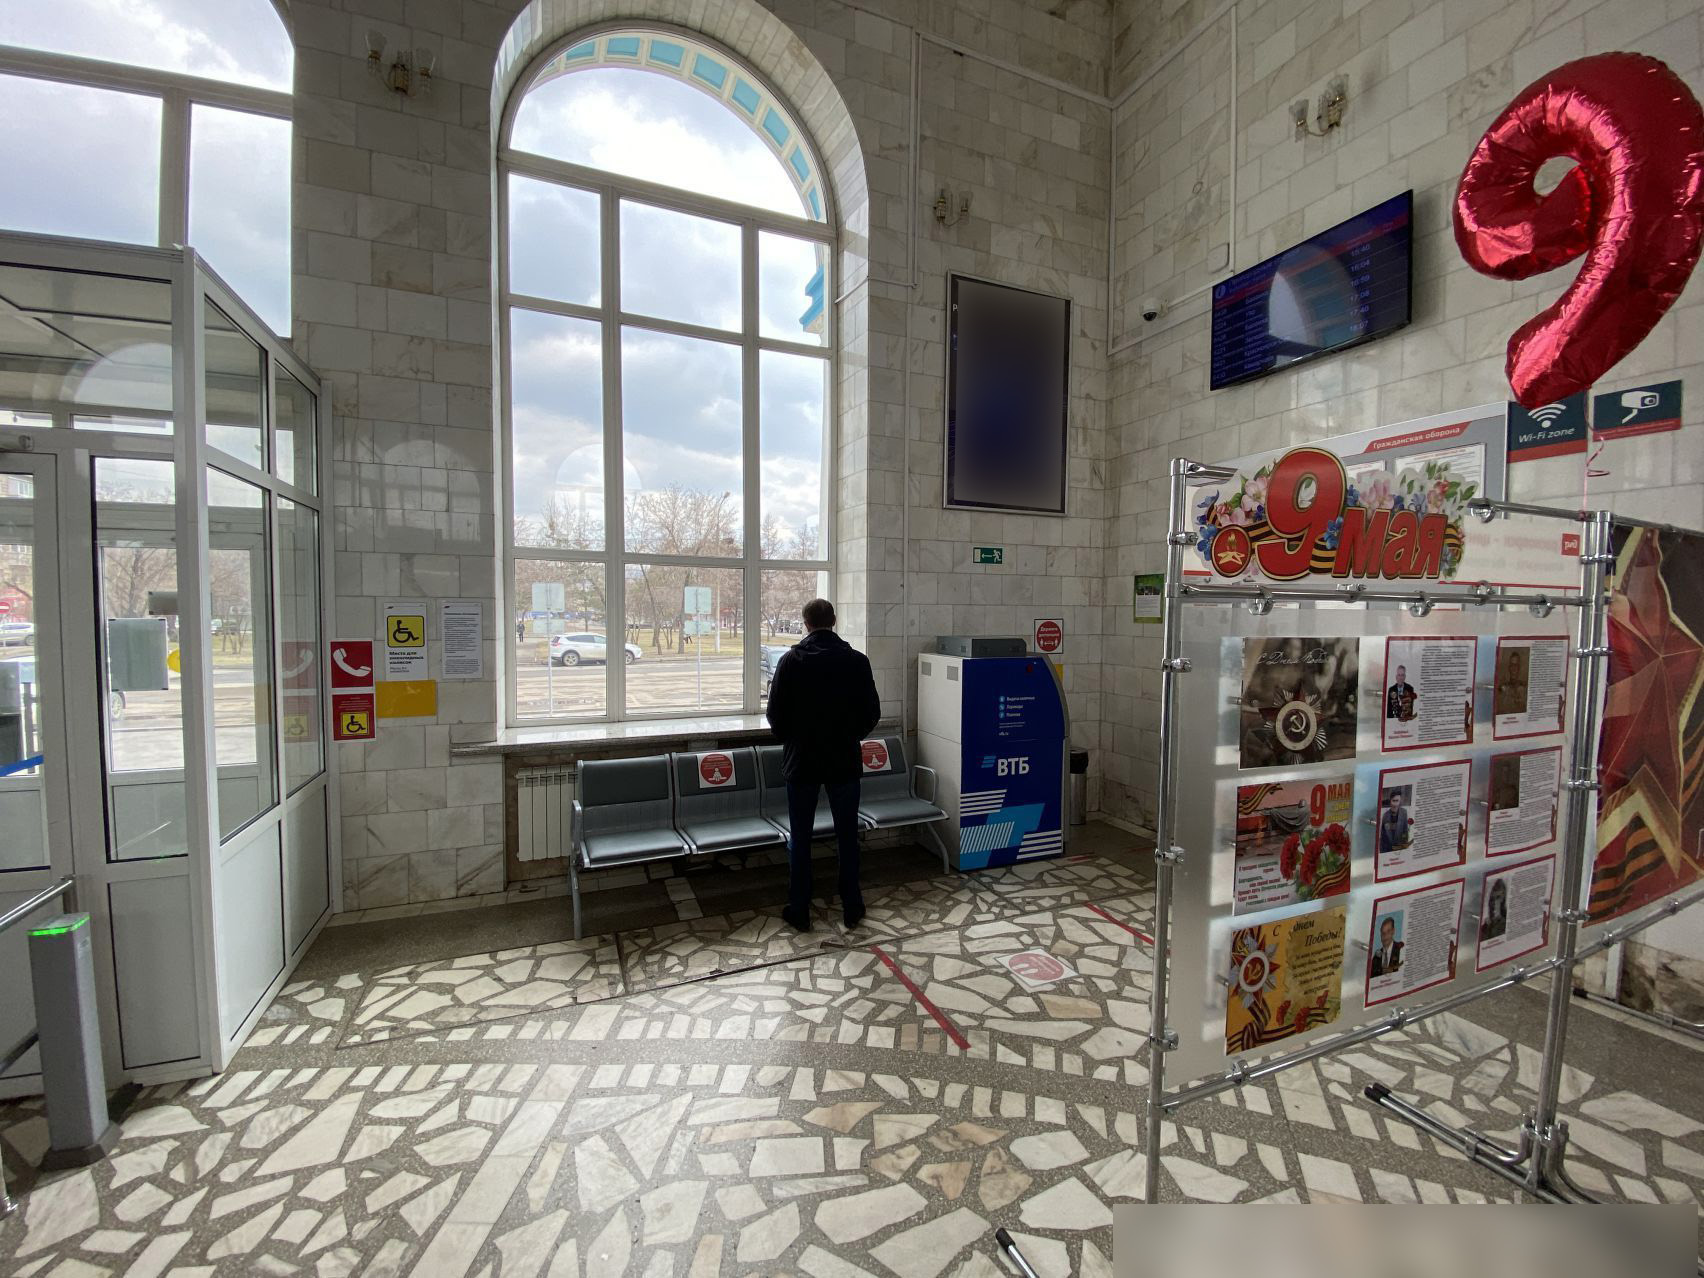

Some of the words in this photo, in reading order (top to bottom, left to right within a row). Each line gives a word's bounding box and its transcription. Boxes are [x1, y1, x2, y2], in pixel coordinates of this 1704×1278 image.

[1373, 434, 1423, 449] Гражданская
[1425, 427, 1460, 439] оборона
[1519, 431, 1546, 443] Wi-Fi
[1547, 427, 1575, 439] zone
[1257, 447, 1347, 580] 9
[997, 757, 1030, 776] ВТБ
[1310, 784, 1327, 828] 9
[1327, 782, 1351, 801] МАЯ
[1272, 924, 1281, 937] С
[1293, 919, 1315, 933] днем
[1304, 927, 1343, 947] Победы!
